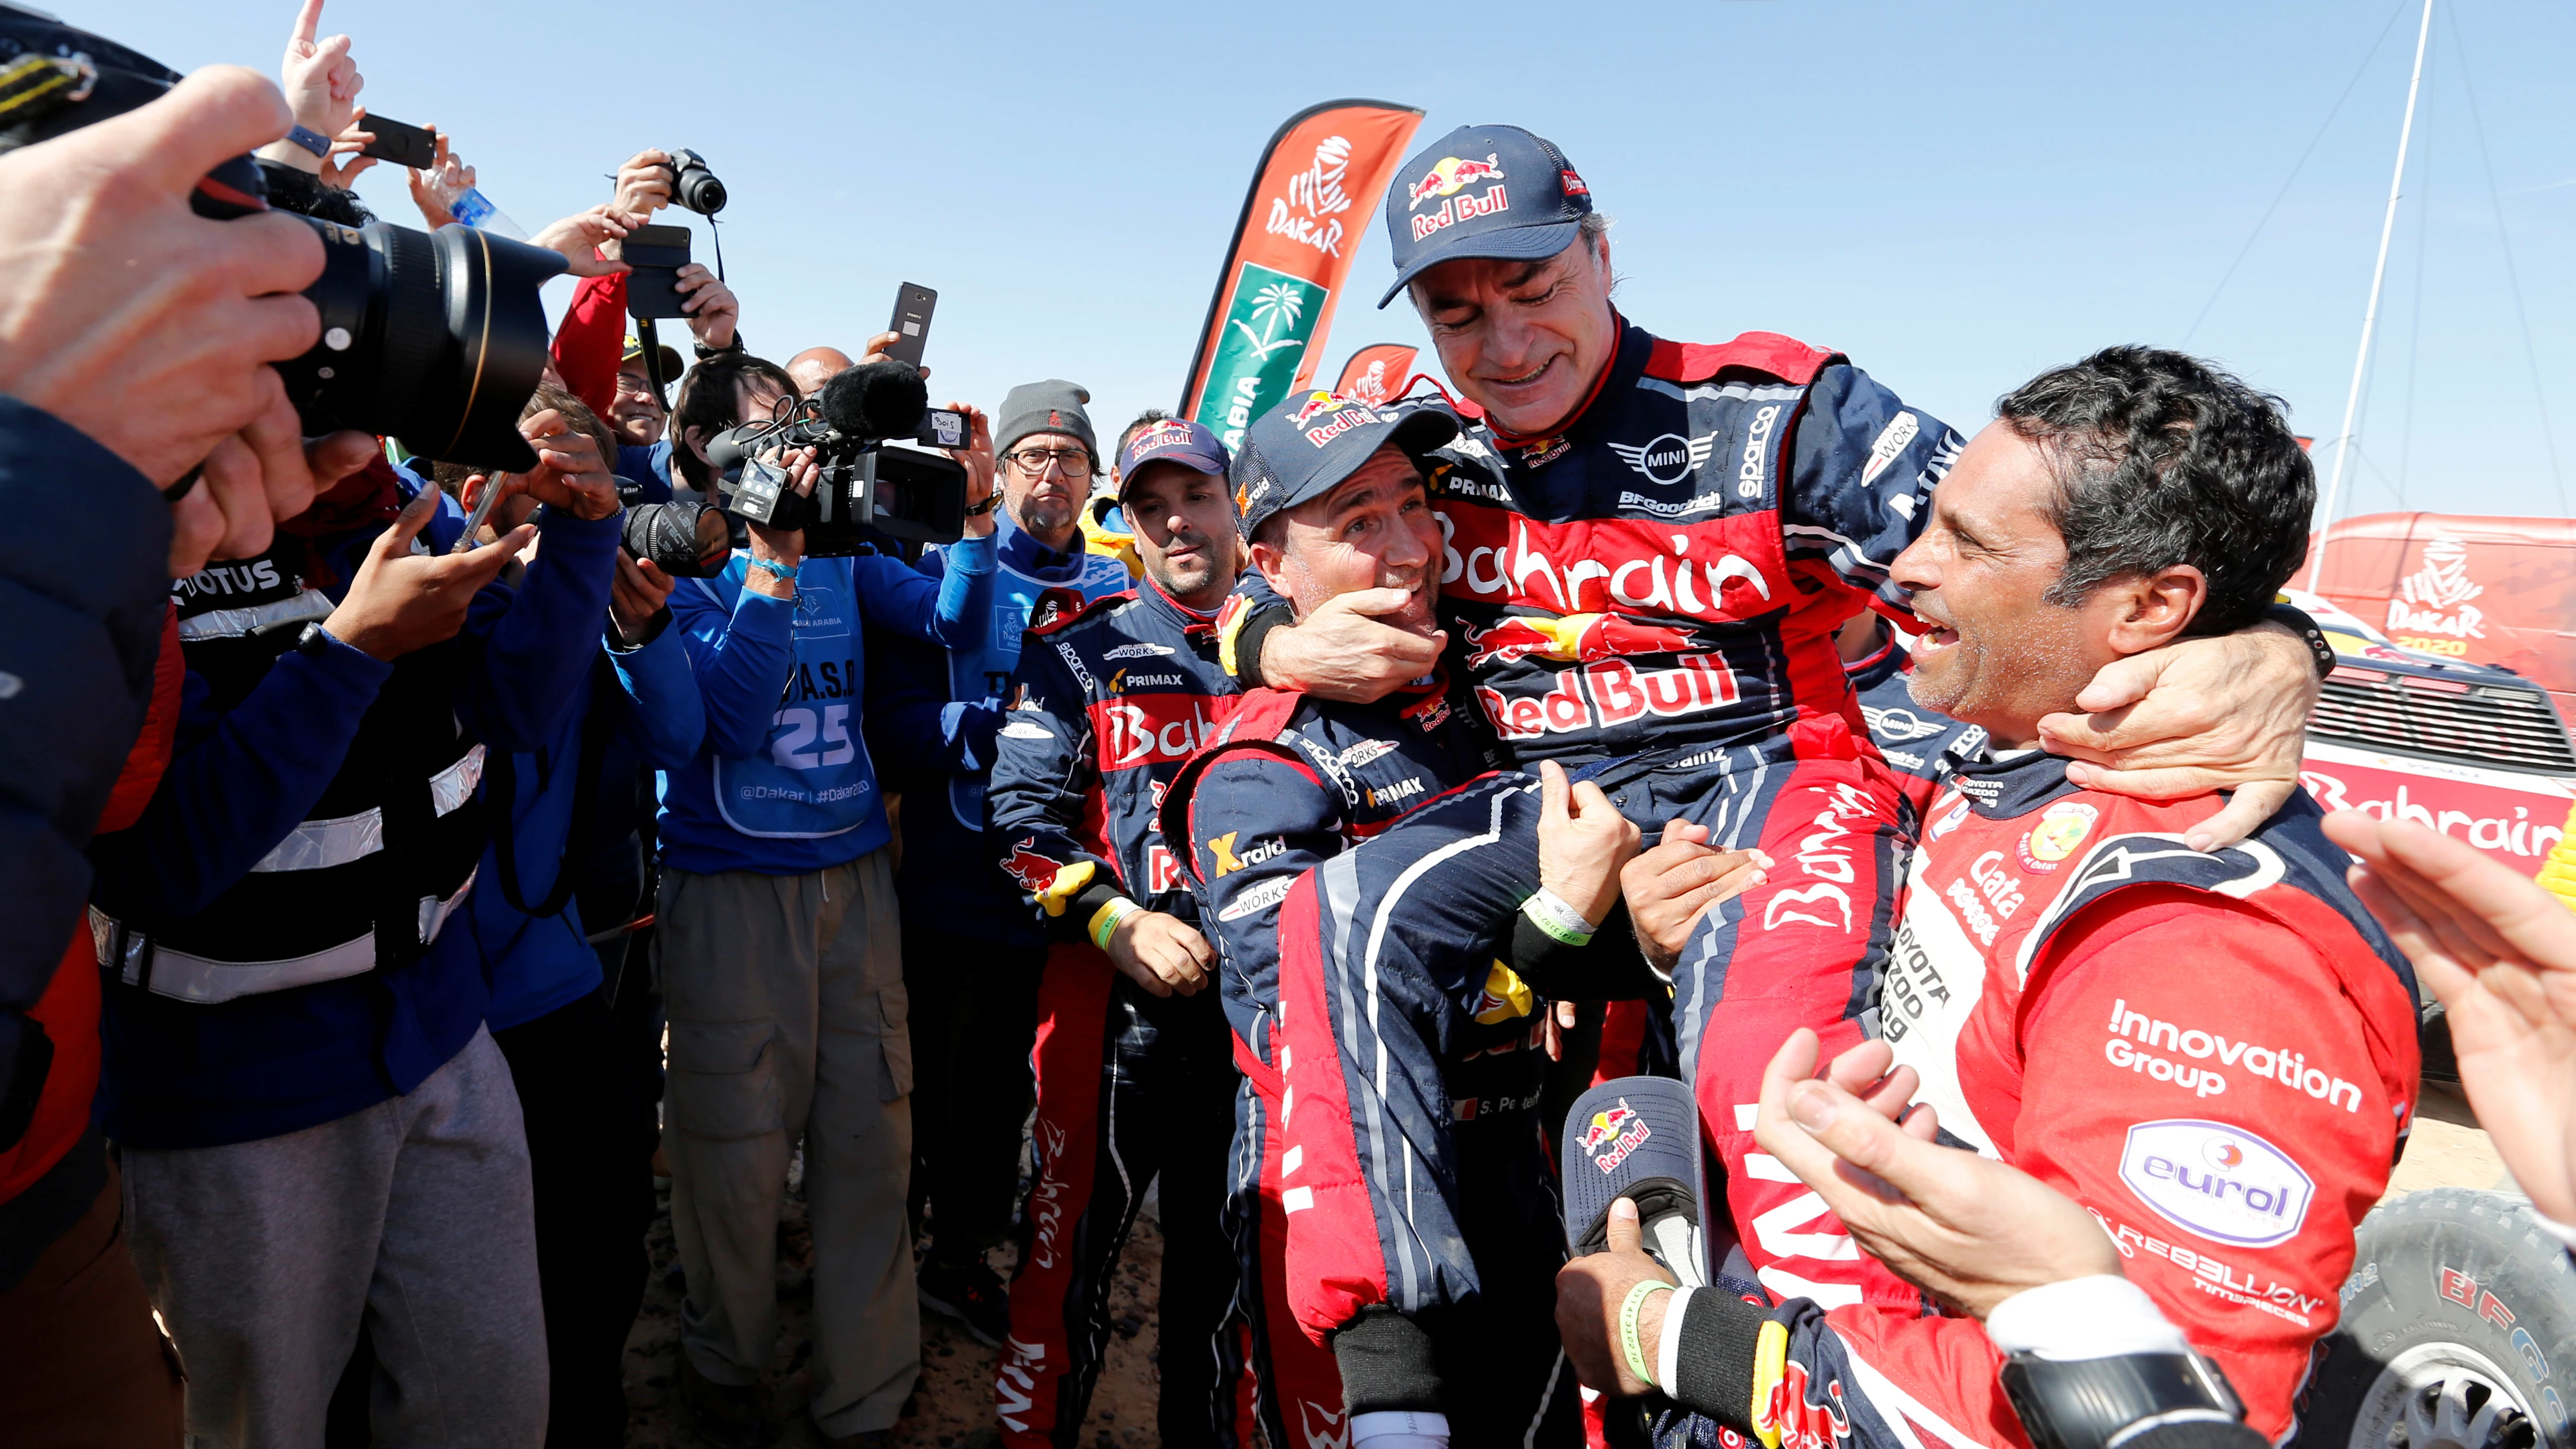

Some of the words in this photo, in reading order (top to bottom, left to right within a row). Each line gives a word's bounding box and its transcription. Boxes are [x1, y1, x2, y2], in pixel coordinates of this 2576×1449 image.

[1411, 196, 1454, 242] Red
[1454, 184, 1509, 222] Bull
[1267, 197, 1343, 259] DAKAR
[1223, 376, 1263, 462] ABIA
[1305, 412, 1350, 449] Red
[1132, 435, 1161, 462] Red
[1159, 431, 1193, 452] Bull
[1527, 452, 1552, 469] Red
[1550, 441, 1572, 459] Bull
[1647, 450, 1686, 468] MINI
[1738, 405, 1780, 499] sparco
[1620, 491, 1721, 514] BFGoodrich
[1432, 519, 1771, 614] Bahrain
[812, 617, 842, 627] ARABIA
[2387, 598, 2485, 638] DAKAR
[1118, 646, 1155, 657] WORKS
[1056, 641, 1094, 693] sparco
[1127, 674, 1183, 687] PRIMAX
[1475, 669, 1593, 741] Red
[1583, 649, 1742, 729] Bull
[771, 703, 855, 770] 25
[1422, 716, 1441, 732] Red
[1880, 717, 1913, 733] MINI
[1350, 744, 1378, 766] ORKS
[740, 785, 804, 802] @Dakar
[1962, 786, 1999, 798] GAZOO
[1979, 796, 1998, 808] ing
[1239, 884, 1290, 913] WORKS
[2105, 1038, 2227, 1098] Group
[1480, 1100, 1494, 1115] S.
[1594, 1142, 1628, 1176] Red
[1618, 1118, 1652, 1155] Bull
[2142, 1154, 2292, 1220] eurol
[1627, 1307, 1633, 1318] 41
[1625, 1321, 1633, 1334] 33
[1627, 1336, 1635, 1349] 02
[1631, 1352, 1639, 1364] 10
